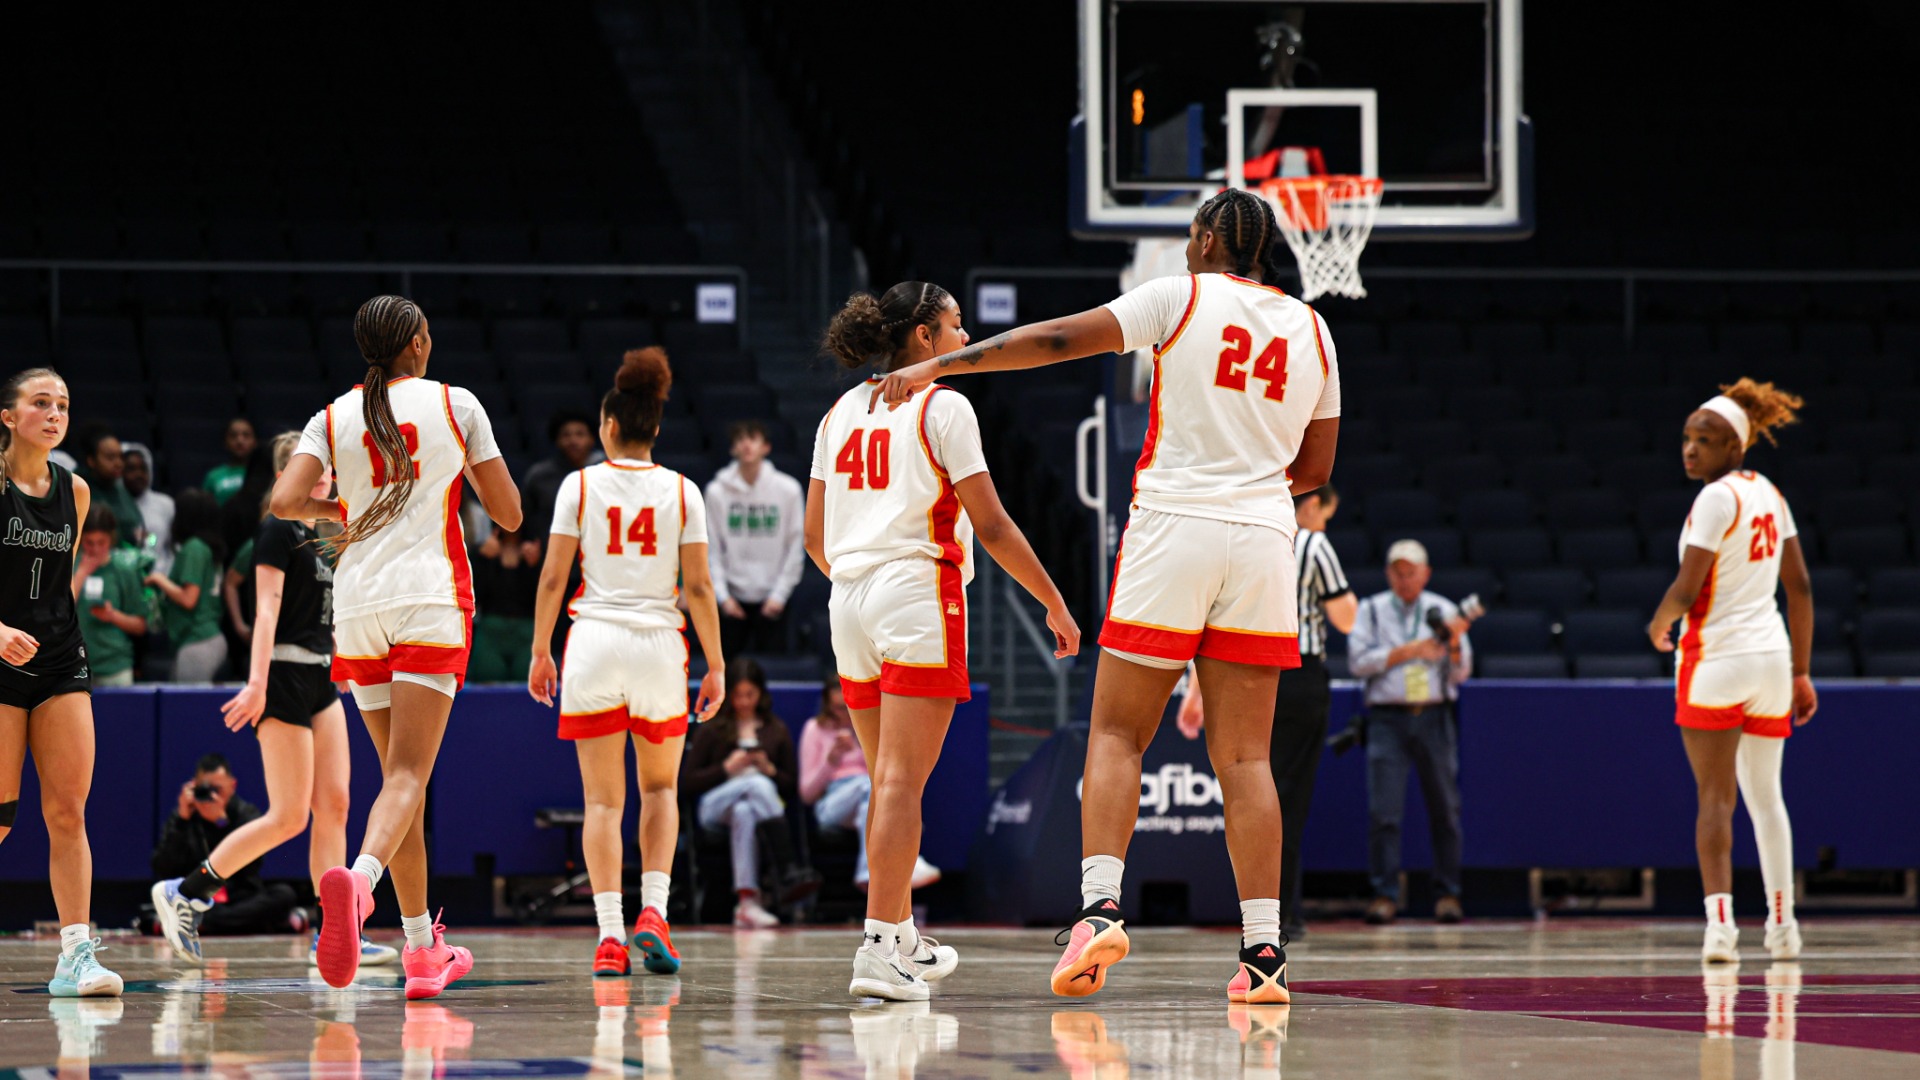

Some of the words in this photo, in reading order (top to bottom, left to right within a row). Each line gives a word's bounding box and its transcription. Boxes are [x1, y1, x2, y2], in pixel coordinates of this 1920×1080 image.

[1214, 323, 1288, 403] 24
[835, 427, 891, 491] 40
[3, 516, 72, 552] Laurel
[606, 506, 657, 556] 14
[1749, 513, 1778, 562] 20
[30, 557, 43, 600] 1
